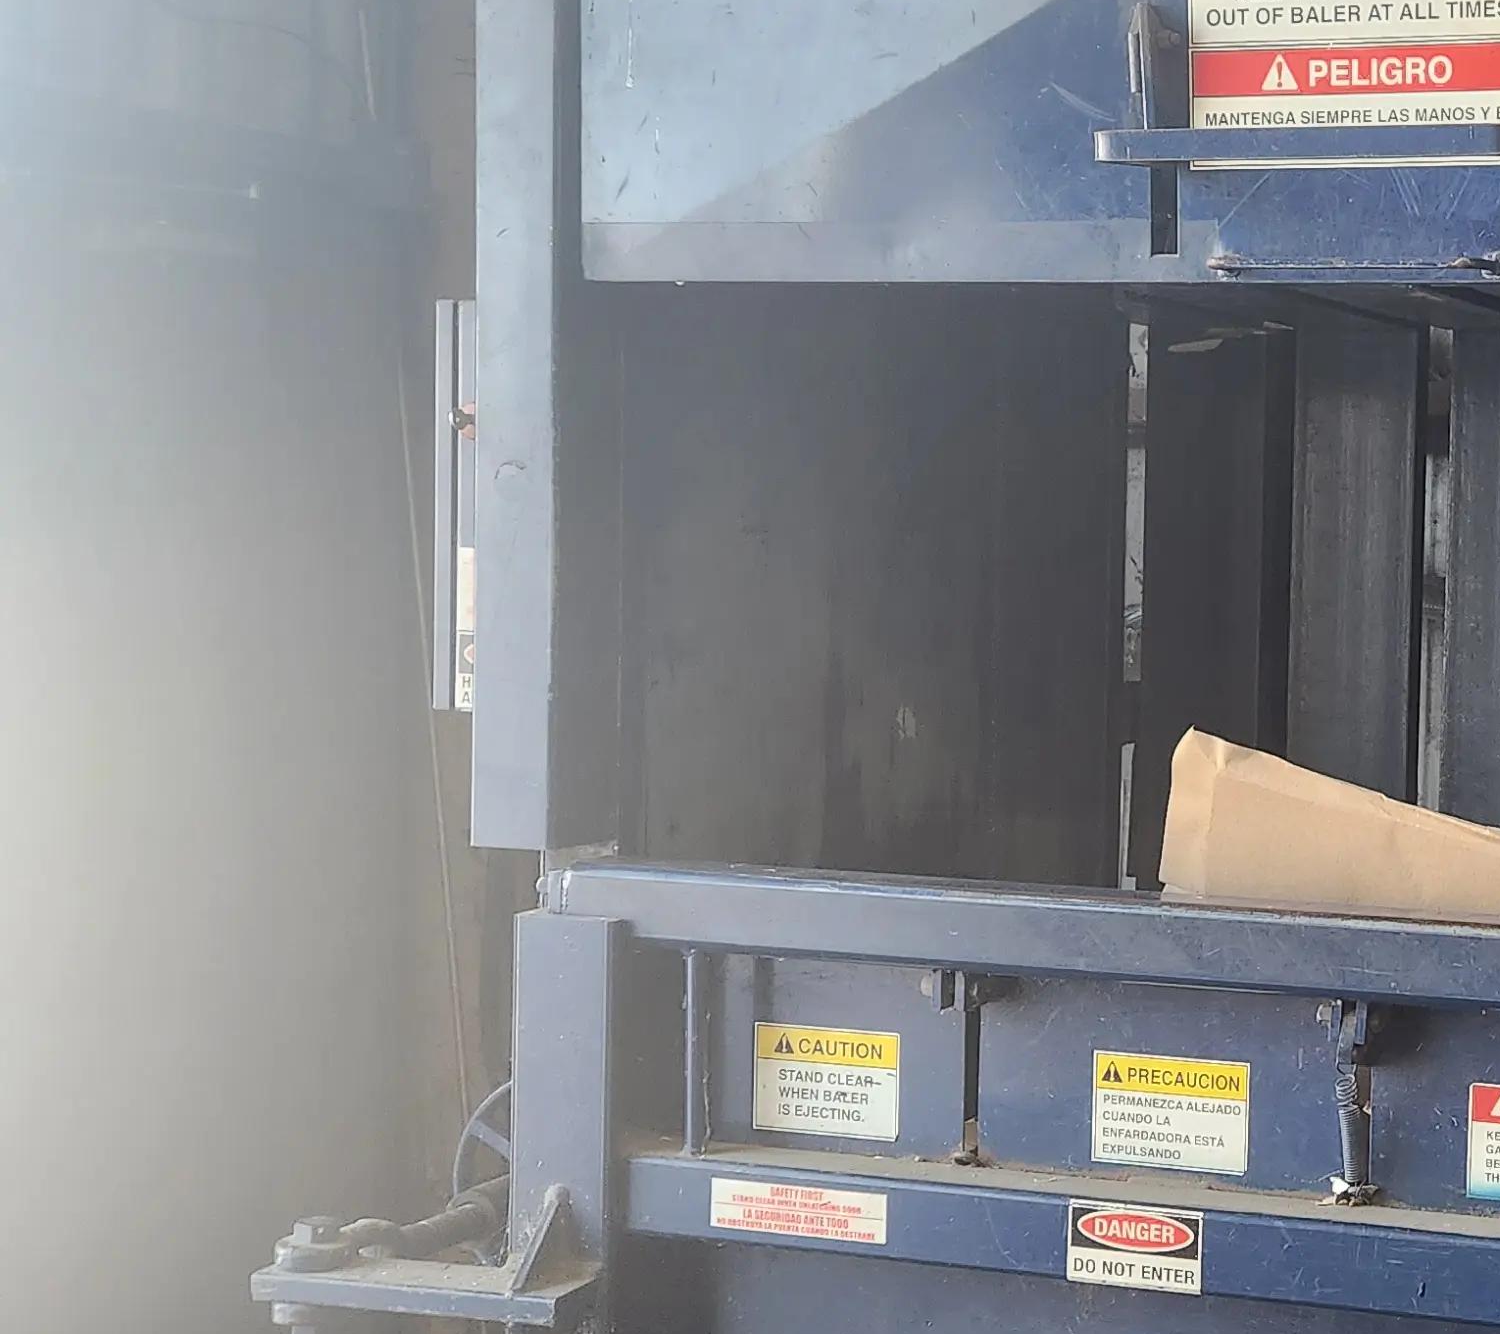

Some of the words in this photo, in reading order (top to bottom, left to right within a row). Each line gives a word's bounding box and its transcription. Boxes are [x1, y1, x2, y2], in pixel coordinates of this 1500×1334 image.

[1206, 8, 1249, 26] OUT
[1255, 7, 1283, 24] OF
[1290, 4, 1360, 23] BALER
[1367, 3, 1393, 21] AT
[1399, 2, 1439, 19] ALL
[1309, 55, 1453, 87] PELIGRO
[1205, 111, 1295, 126] MANTENGA
[1300, 109, 1372, 123] SIEMPRE
[1378, 108, 1409, 122] LAS
[1415, 106, 1474, 121] MANOS
[1480, 106, 1489, 120] Y
[799, 1038, 882, 1059] CAUTION
[777, 1068, 823, 1083] STAND
[827, 1072, 875, 1087] CLEAR
[1127, 1067, 1240, 1092] PRECAUCION
[778, 1085, 818, 1100] WHEN
[823, 1090, 868, 1104] BALER
[1103, 1094, 1183, 1109] PERMANEZCA
[1185, 1101, 1240, 1115] ALEJADO
[777, 1102, 790, 1115] IS
[794, 1104, 864, 1121] EJECTING.
[1102, 1110, 1152, 1124] CUANDO
[1156, 1114, 1171, 1126] LA
[1102, 1127, 1191, 1143] ENFARDADORA
[1102, 1144, 1181, 1159] EXPULSANDO
[1094, 1217, 1175, 1244] DANGER
[1073, 1257, 1095, 1273] DO
[1102, 1260, 1135, 1276] NOT
[1141, 1265, 1194, 1284] ENTER
